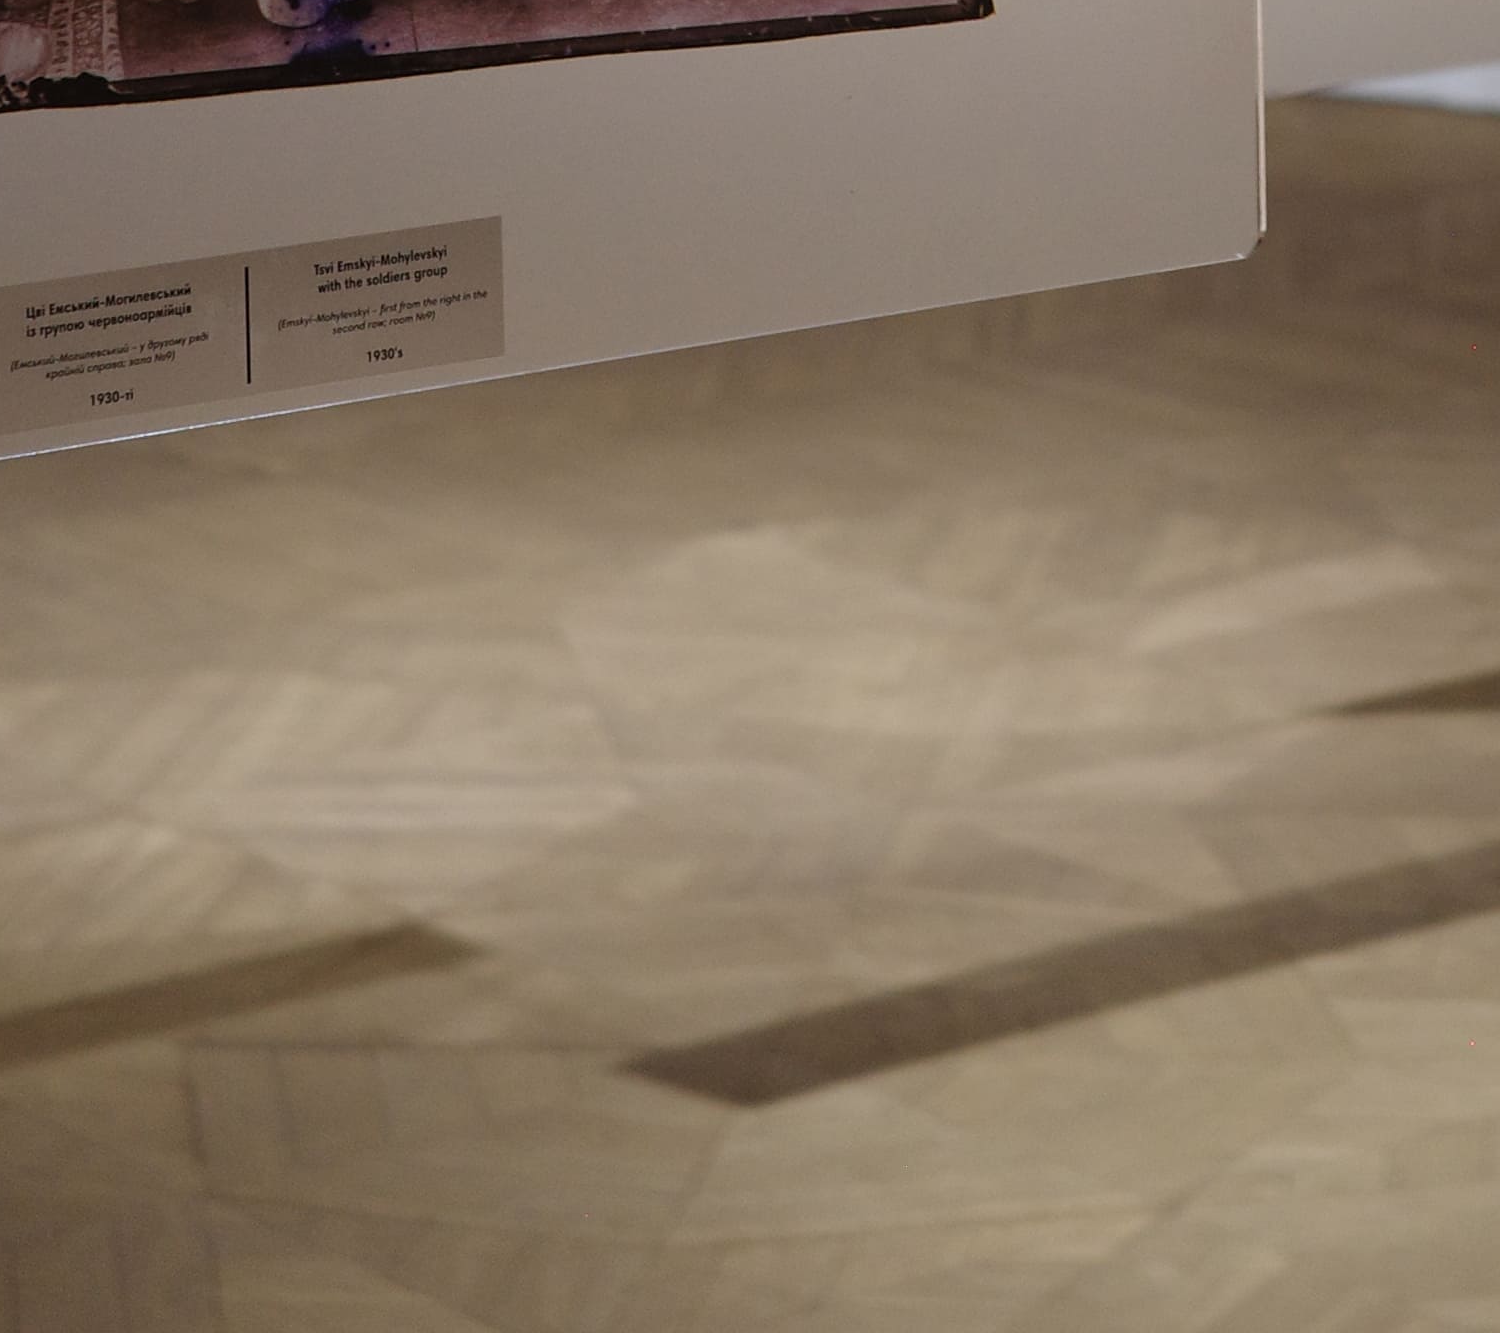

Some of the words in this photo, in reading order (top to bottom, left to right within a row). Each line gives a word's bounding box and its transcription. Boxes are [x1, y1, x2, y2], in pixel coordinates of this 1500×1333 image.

[314, 261, 334, 276] Tsvi
[337, 245, 447, 272] Emskyi-Mohylevskyi
[318, 279, 341, 293] with
[345, 276, 362, 290] the
[366, 271, 410, 286] soldiers
[414, 266, 448, 283] group
[26, 304, 45, 320] Цві
[50, 283, 191, 315] Емський-Могилевський
[278, 307, 370, 332] (Emskyi-Mohylevskyi
[379, 303, 397, 316] first
[399, 301, 421, 314] from
[423, 296, 437, 306] the
[439, 294, 461, 306] right
[463, 292, 471, 301] in
[473, 289, 488, 299] the
[26, 326, 36, 337] із
[40, 319, 84, 338] групою
[89, 304, 192, 330] червоноармійців
[332, 319, 365, 335] second
[389, 315, 413, 326] room
[90, 388, 134, 406] 1930-ті
